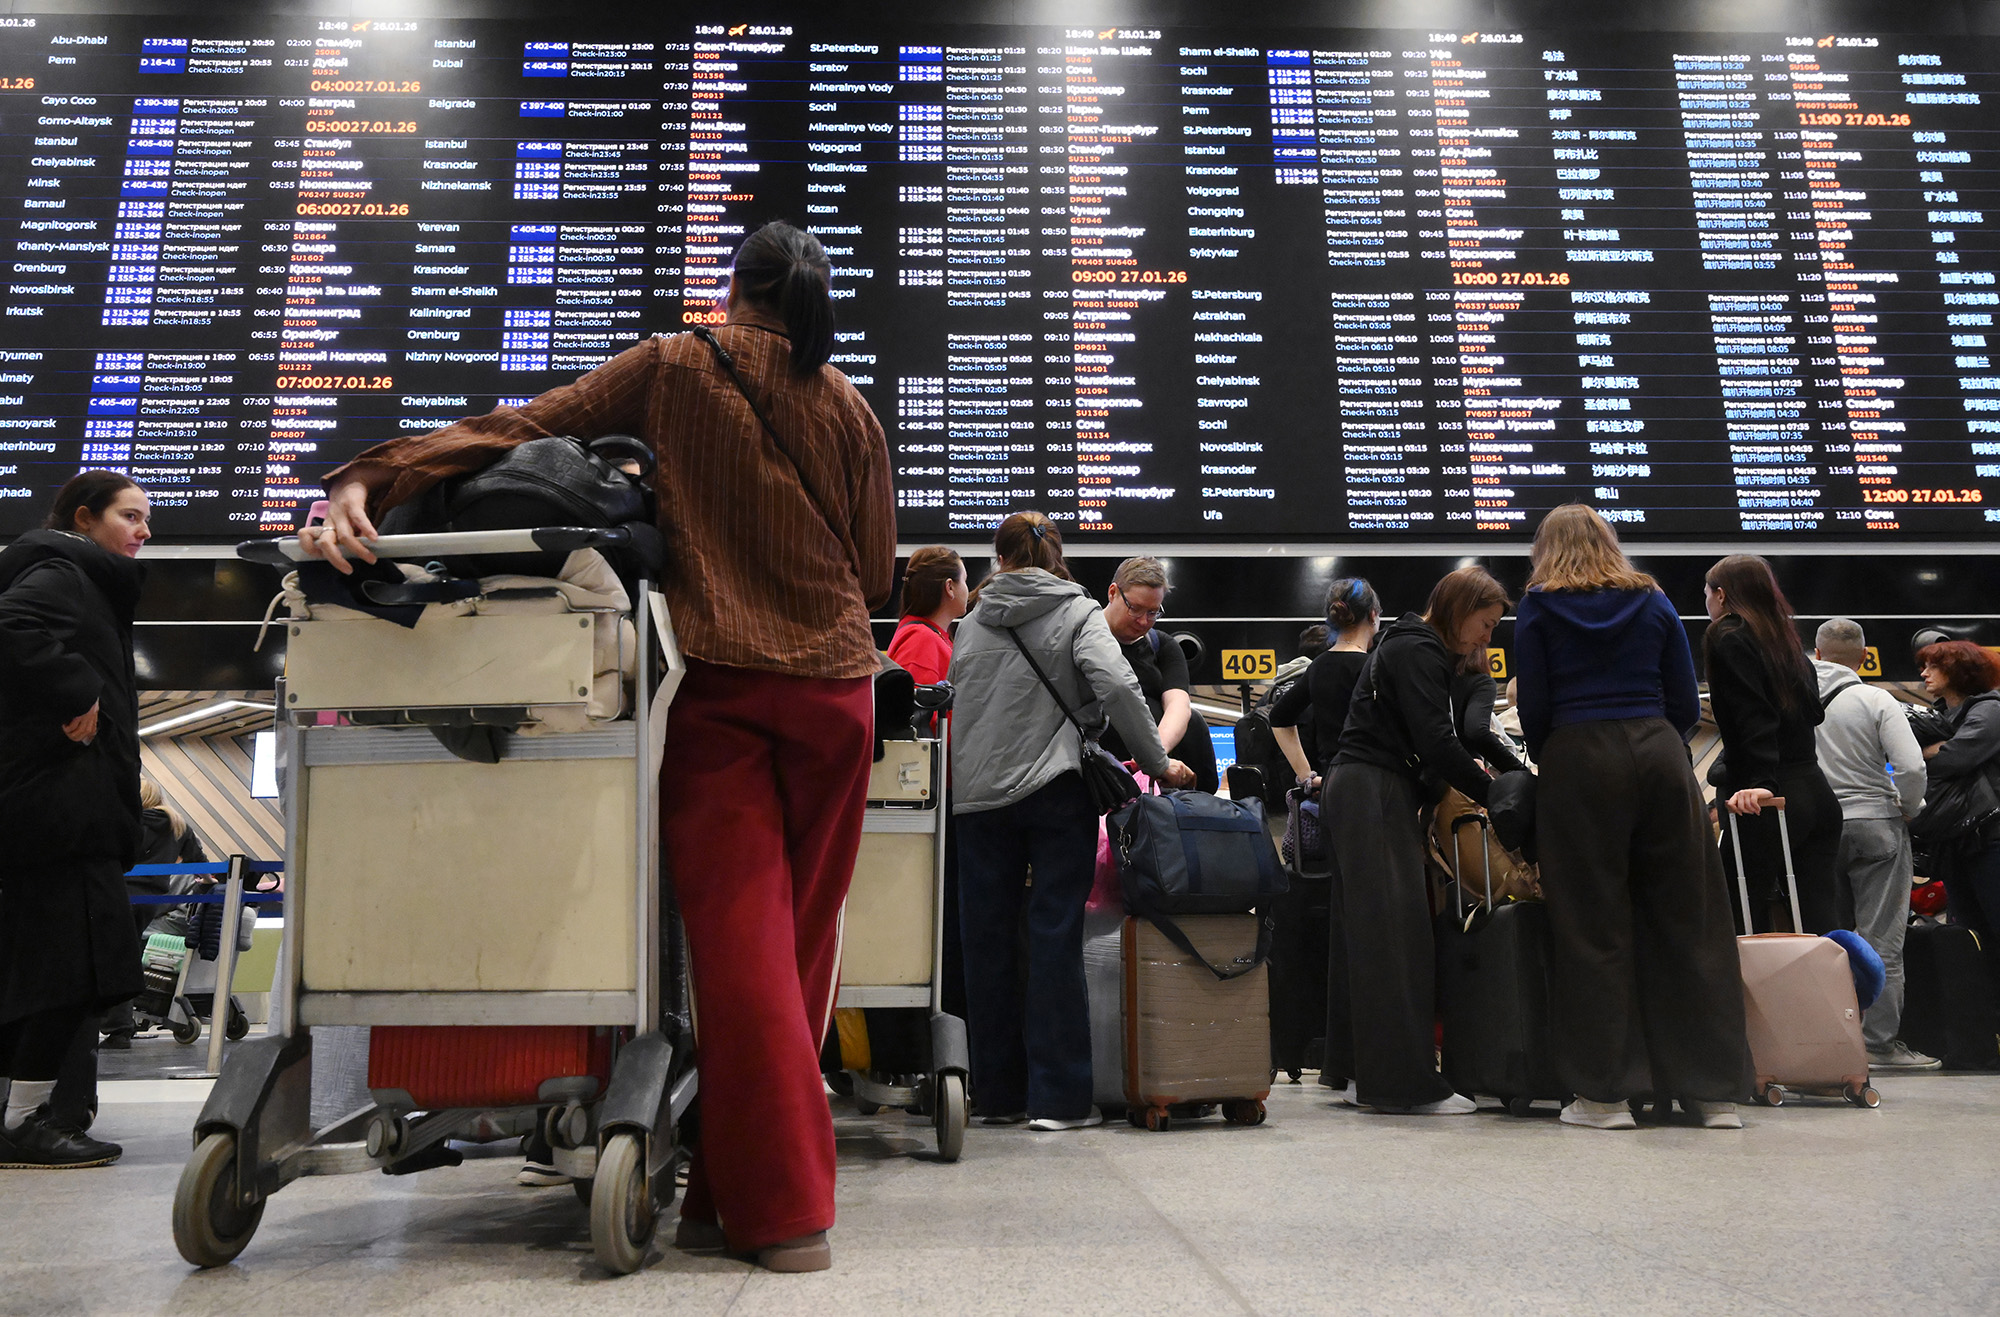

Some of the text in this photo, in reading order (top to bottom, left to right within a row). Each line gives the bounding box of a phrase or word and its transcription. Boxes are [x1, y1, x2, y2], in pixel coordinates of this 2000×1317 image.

[319, 22, 347, 30] 18:49
[696, 26, 792, 35] 18:49 26.01.26
[1066, 30, 1094, 38] 18:49
[51, 36, 107, 44] Abu-Dhabi
[435, 40, 475, 48] Istanbul
[810, 44, 878, 54] St.Petersburg
[1214, 48, 1259, 56] el-Sheikh
[49, 56, 75, 64] Perm
[1181, 67, 1207, 75] Sochi
[810, 83, 893, 93] Mineralnye Vody
[42, 96, 67, 106] Cayo
[429, 99, 475, 109] Belgrade
[809, 103, 836, 111] Sochi
[38, 117, 112, 126] Gorno-Altaysk
[1800, 114, 1910, 125] 11:00 27.01.26
[1183, 126, 1251, 136] St.Petersburg
[35, 137, 77, 145] Istanbul
[426, 140, 467, 148] Istanbul
[808, 143, 861, 153] Volgograd
[31, 158, 96, 168] Chelyabinsk
[424, 161, 477, 169] Krasnodar
[808, 163, 867, 171] Vladikavkaz
[1186, 166, 1238, 175] Krasnodar
[28, 179, 60, 187] Minsk
[422, 181, 491, 190] Nizhnekamsk
[808, 184, 845, 192] Izhevsk
[1186, 187, 1239, 197] Volgograd
[1188, 207, 1244, 217] Chongqing
[21, 221, 97, 231] Magnitogorsk
[417, 223, 459, 231] Yerevan
[807, 226, 862, 234] Murmansk
[1189, 227, 1254, 238] Ekaterinburg
[17, 242, 110, 252] Khanty-Mansiysk
[416, 244, 455, 252] Samara
[1190, 248, 1239, 258] Syktyvkar
[14, 264, 66, 274] Orenburg
[414, 266, 469, 274] Krasnodar
[1072, 271, 1187, 283] 09:00 27.01.26
[1454, 273, 1570, 285] 10:00 27.01.26
[10, 285, 74, 293] Novosibirsk
[412, 287, 497, 295] Sharm el-Sheikh
[1192, 290, 1262, 301] St.Petersburg
[6, 307, 43, 315] Irkutsk
[410, 308, 470, 319] Kaliningrad
[1193, 312, 1245, 320] Astrakhan
[408, 330, 460, 341] Orenburg
[1195, 333, 1262, 341] Makhachkala
[406, 352, 499, 363] Nizhny Novgorod
[1196, 355, 1236, 363] Bokhtar
[277, 377, 392, 388] 07:0027.01.26
[1197, 376, 1260, 387] Chelyabinsk
[401, 396, 467, 407] Chelyabinsk
[1197, 398, 1247, 408] Stavropol
[1199, 420, 1227, 429] Sochi
[1200, 442, 1263, 451] Novosibirsk
[1201, 465, 1256, 474] Krasnodar
[1202, 488, 1274, 498] St.Petersburg
[1863, 490, 1982, 502] 12:00 27.01.26
[1204, 510, 1222, 519] Ufa
[1226, 655, 1272, 674] 405
